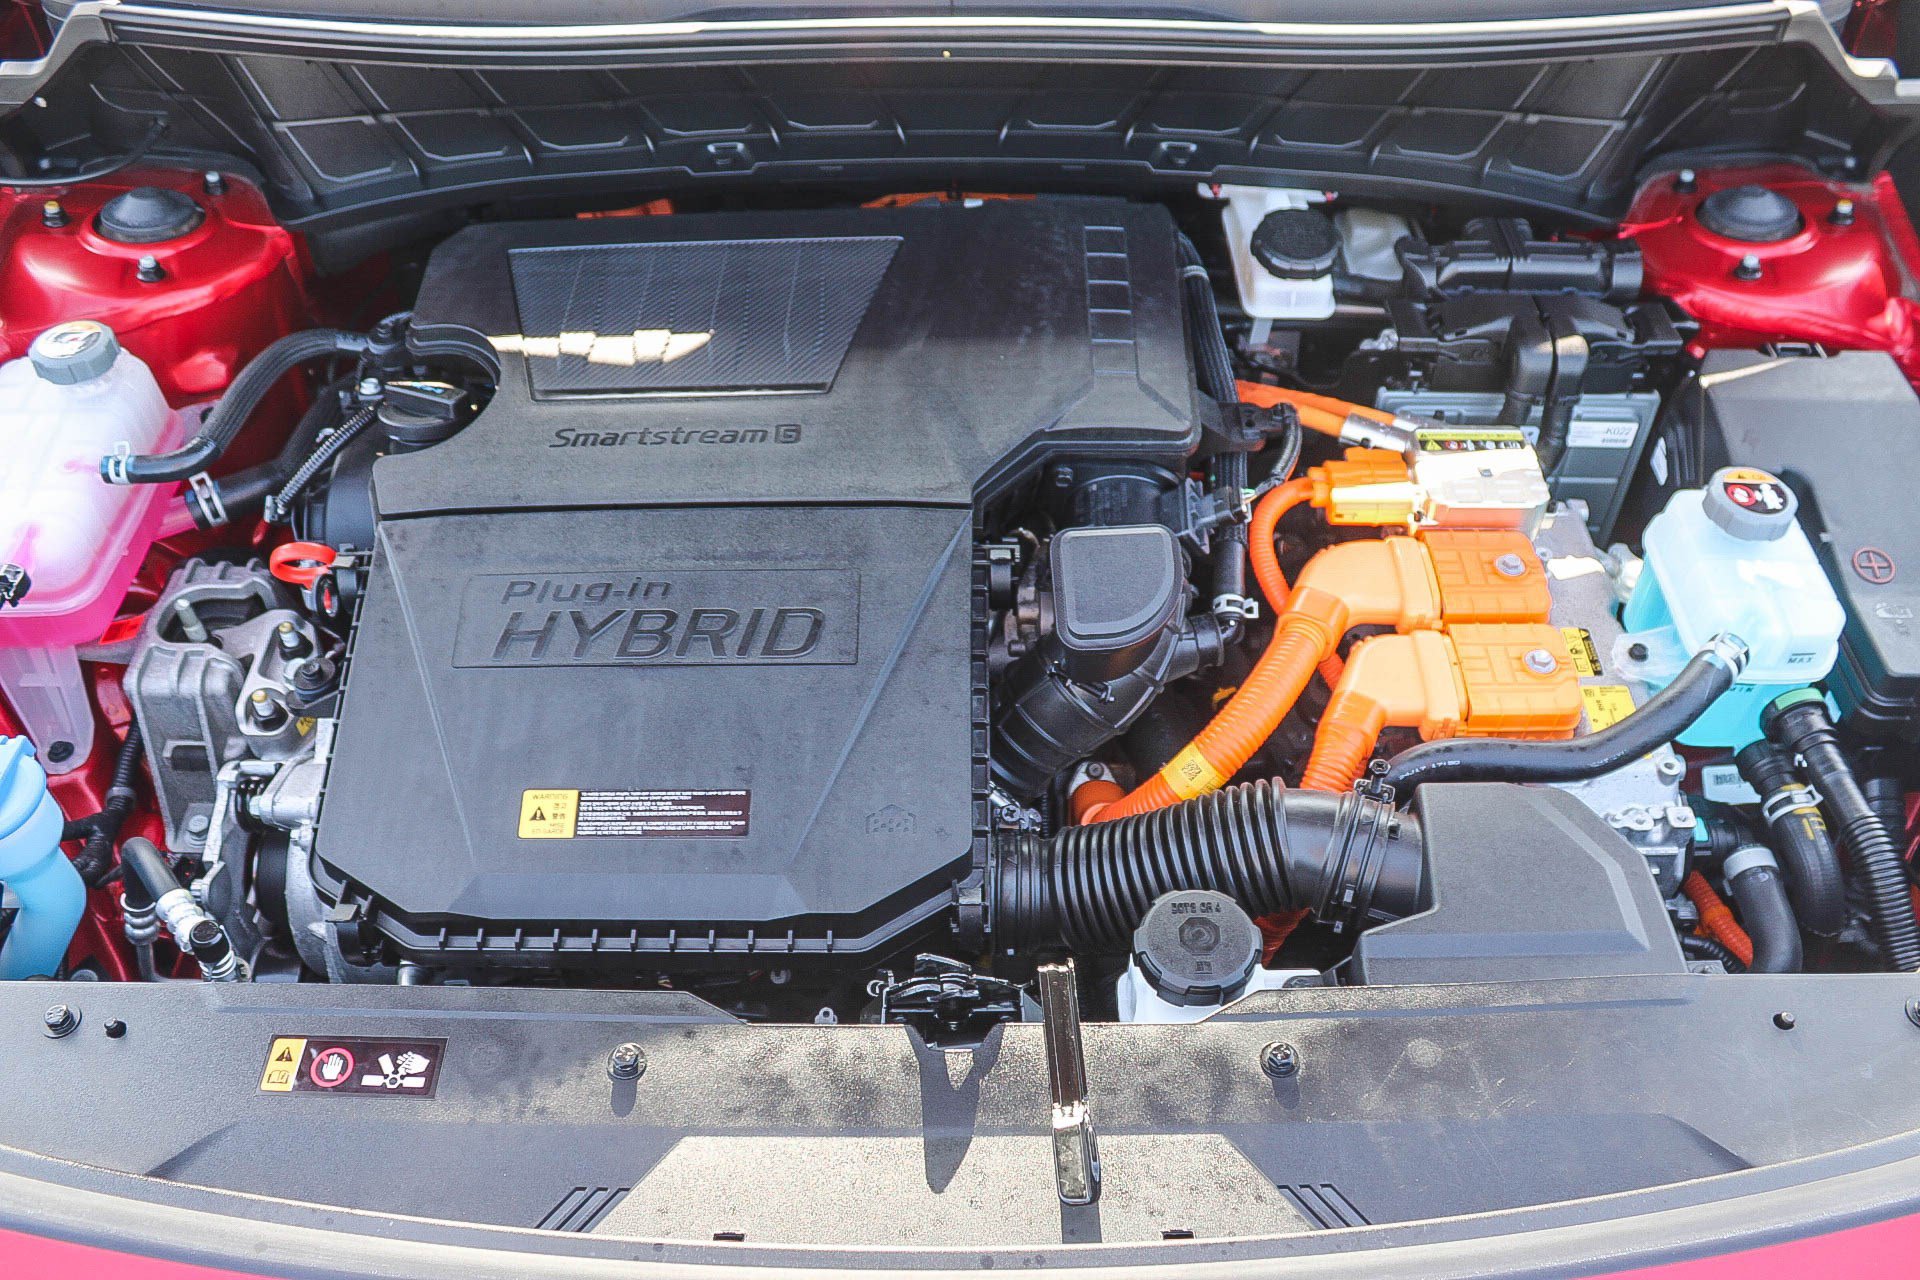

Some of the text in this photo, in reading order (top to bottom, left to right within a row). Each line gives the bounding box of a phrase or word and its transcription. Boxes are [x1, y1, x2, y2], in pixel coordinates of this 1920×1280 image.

[549, 427, 768, 448] Smartstream
[501, 576, 673, 606] Plug-in
[491, 606, 826, 661] HYBRID
